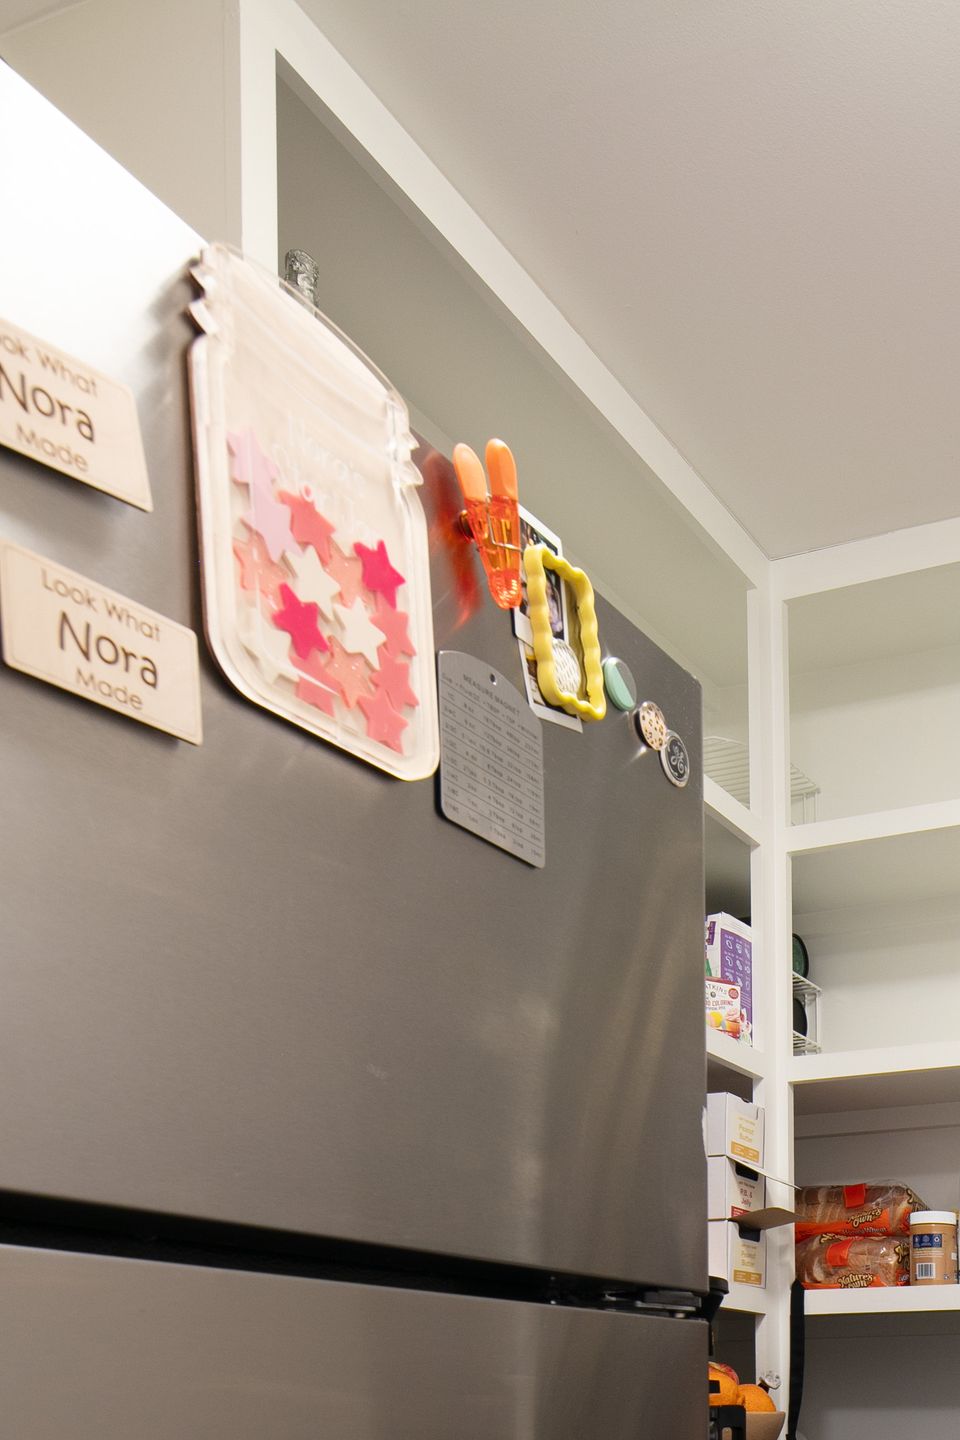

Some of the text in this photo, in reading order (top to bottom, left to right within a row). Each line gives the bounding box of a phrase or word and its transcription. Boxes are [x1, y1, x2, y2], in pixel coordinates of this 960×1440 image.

[0, 361, 95, 443] Nora
[36, 348, 98, 397] What
[16, 423, 90, 472] Made
[41, 567, 161, 643] Look What
[58, 610, 159, 690] Nora
[76, 667, 144, 711] Made
